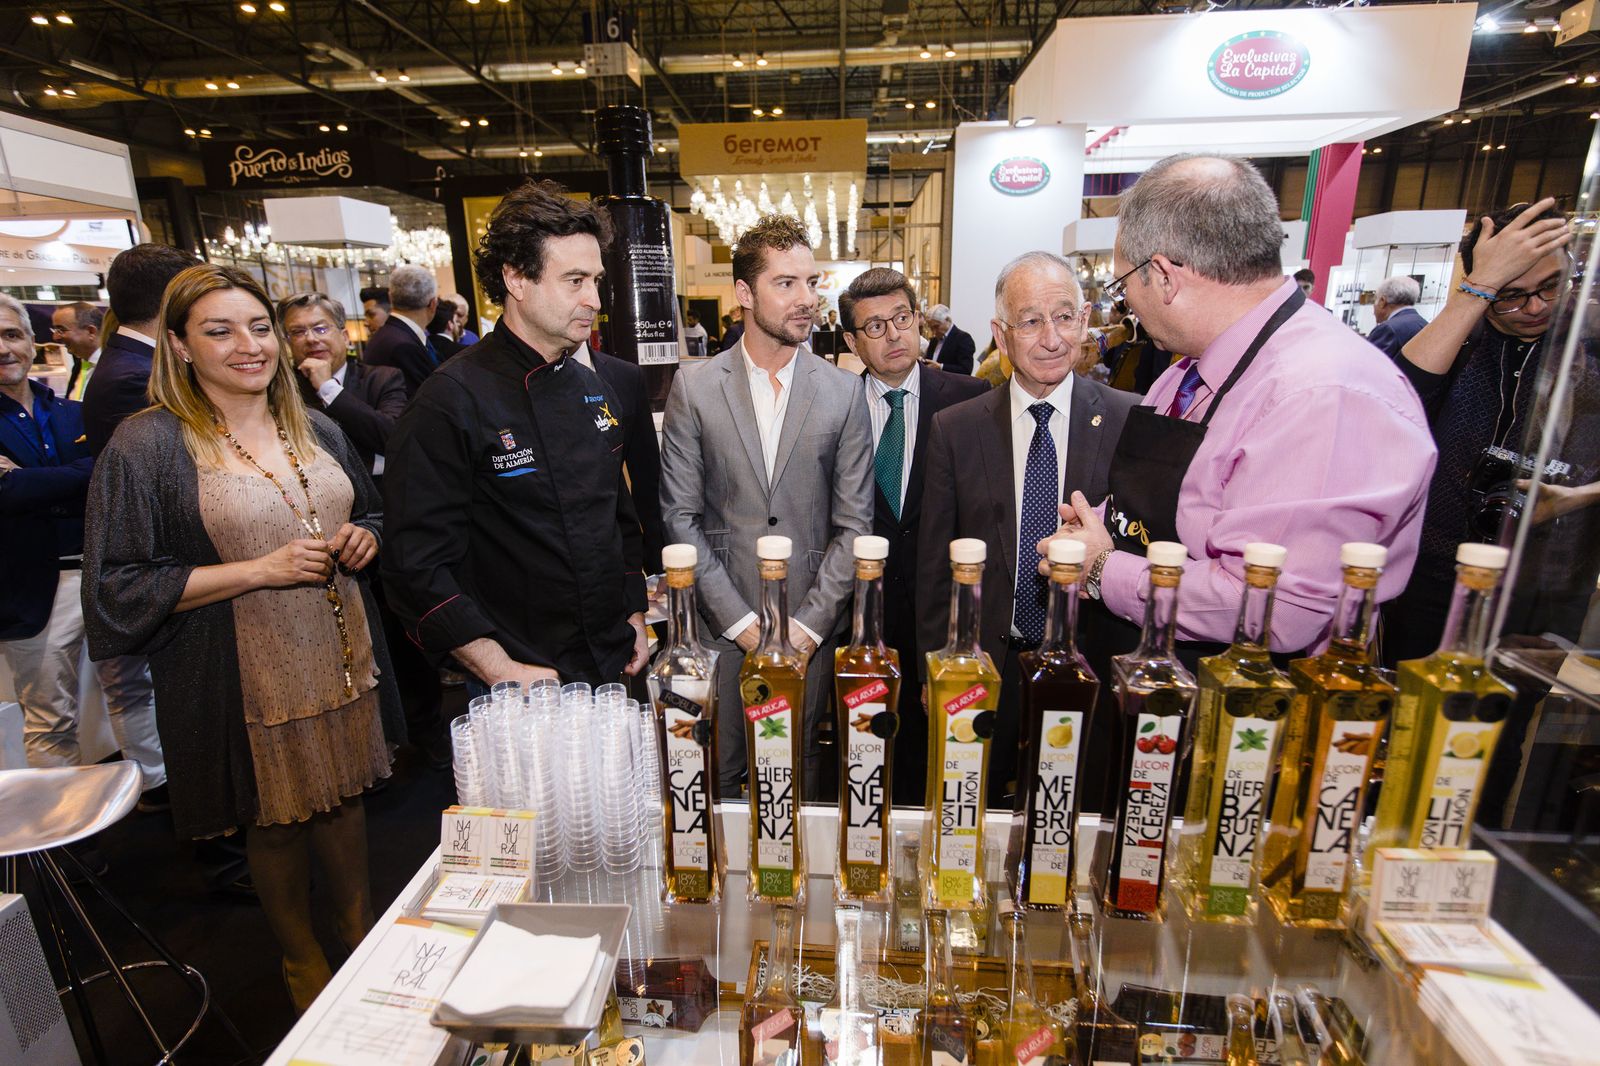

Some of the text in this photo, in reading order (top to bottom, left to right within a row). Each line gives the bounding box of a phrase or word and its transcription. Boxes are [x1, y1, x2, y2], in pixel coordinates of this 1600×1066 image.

[607, 17, 619, 38] 6
[1222, 48, 1297, 64] Exclusivas
[1220, 62, 1296, 80] La Capital
[724, 134, 822, 154] бегемот
[229, 146, 288, 187] Puerto
[296, 147, 353, 178] Indias
[492, 448, 533, 463] DIPUTACIÓN
[505, 455, 535, 469] ALMERÍA
[849, 744, 882, 754] LICOR
[669, 749, 701, 759] LICOR
[849, 752, 862, 761] DE
[757, 757, 771, 765] DE
[945, 760, 960, 769] DE
[1040, 761, 1054, 770] DE
[1134, 760, 1170, 771] LICOR
[1133, 770, 1148, 779] DE
[1228, 770, 1243, 779] DE
[1326, 765, 1362, 775] LICOR
[1436, 777, 1451, 786] DE
[958, 858, 970, 866] DE
[1051, 862, 1063, 870] DE
[1141, 869, 1154, 877] DE
[1233, 872, 1246, 880] DE
